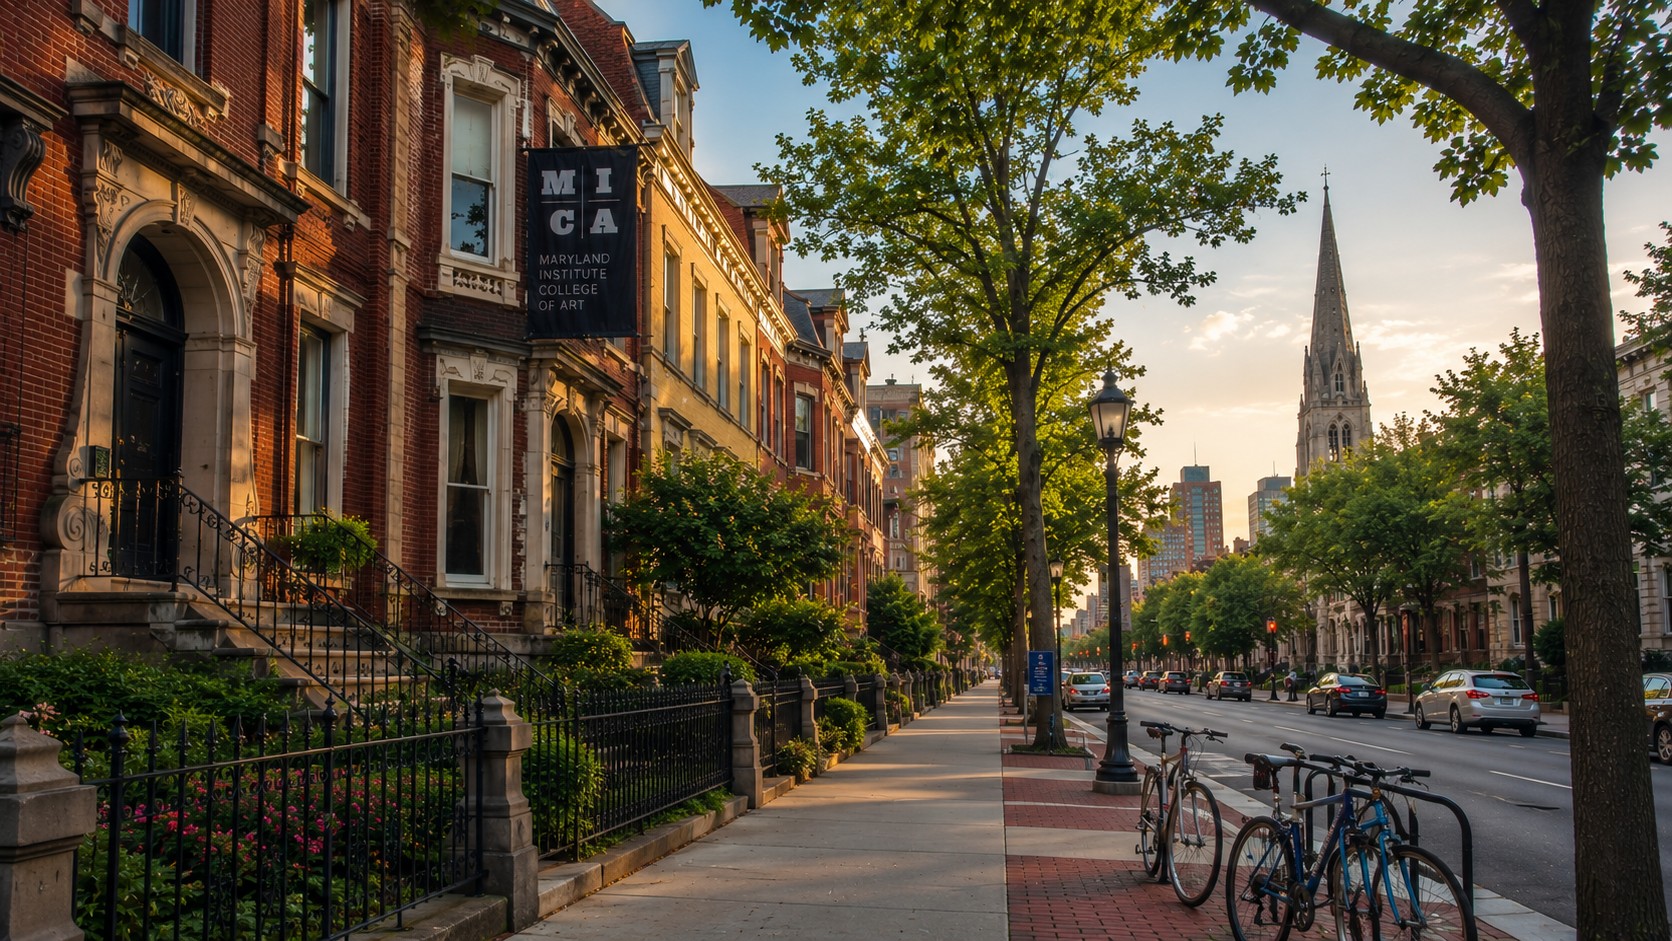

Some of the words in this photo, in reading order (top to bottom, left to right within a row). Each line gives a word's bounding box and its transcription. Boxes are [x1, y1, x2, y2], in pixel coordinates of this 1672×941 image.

[539, 253, 610, 265] MARYLAND
[539, 268, 607, 280] INSTITUTE
[538, 283, 598, 296] COLLEGE
[538, 299, 555, 311] OF
[559, 299, 585, 310] ART
